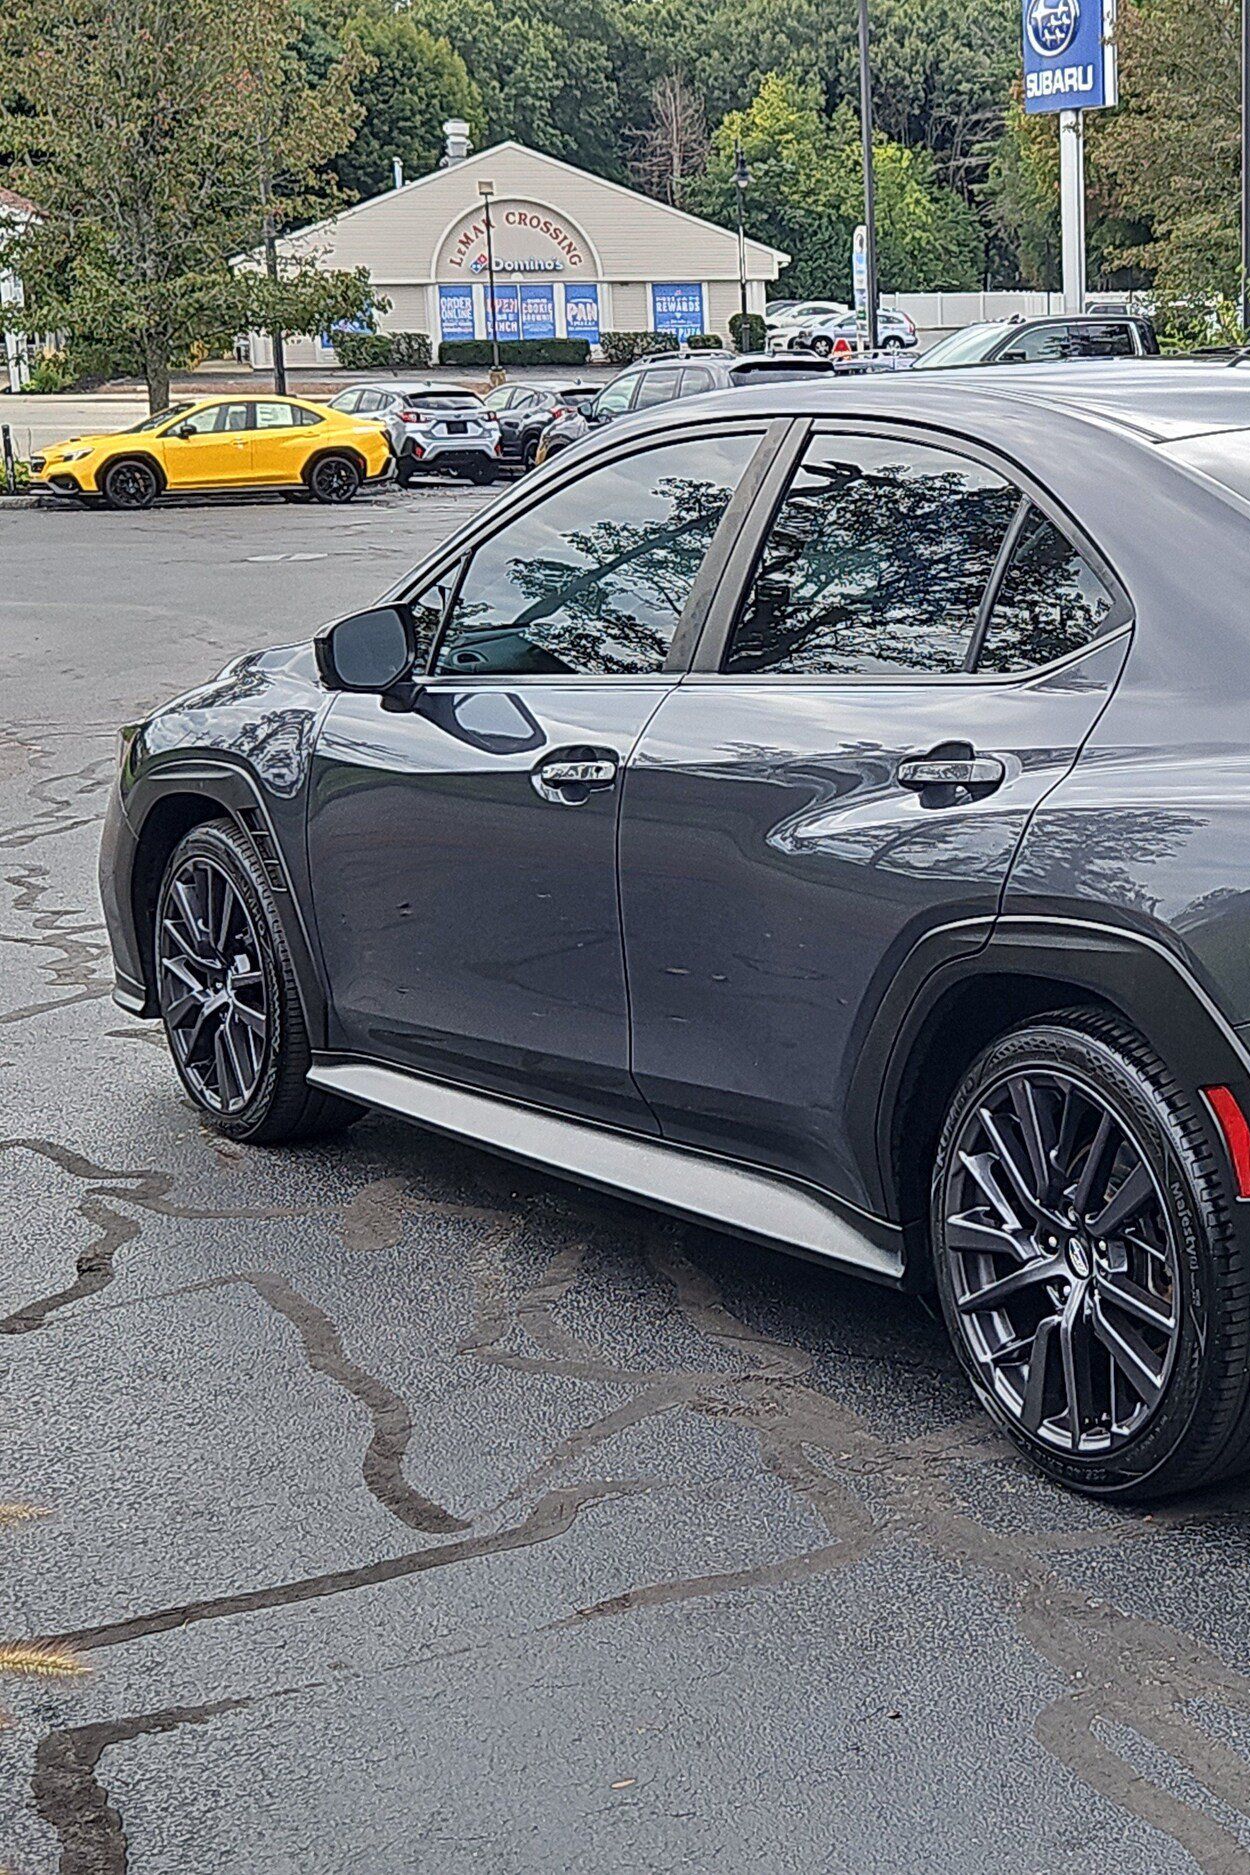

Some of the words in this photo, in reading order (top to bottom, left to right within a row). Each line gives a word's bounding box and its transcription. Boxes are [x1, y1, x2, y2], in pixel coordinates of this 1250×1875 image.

[1026, 65, 1094, 98] SUBARU
[505, 212, 583, 266] CROSSING
[491, 257, 564, 271] Domino's
[440, 297, 472, 309] ORDER
[656, 301, 700, 312] REWARDS
[441, 308, 473, 320] ONLINE
[566, 303, 597, 321] PAN
